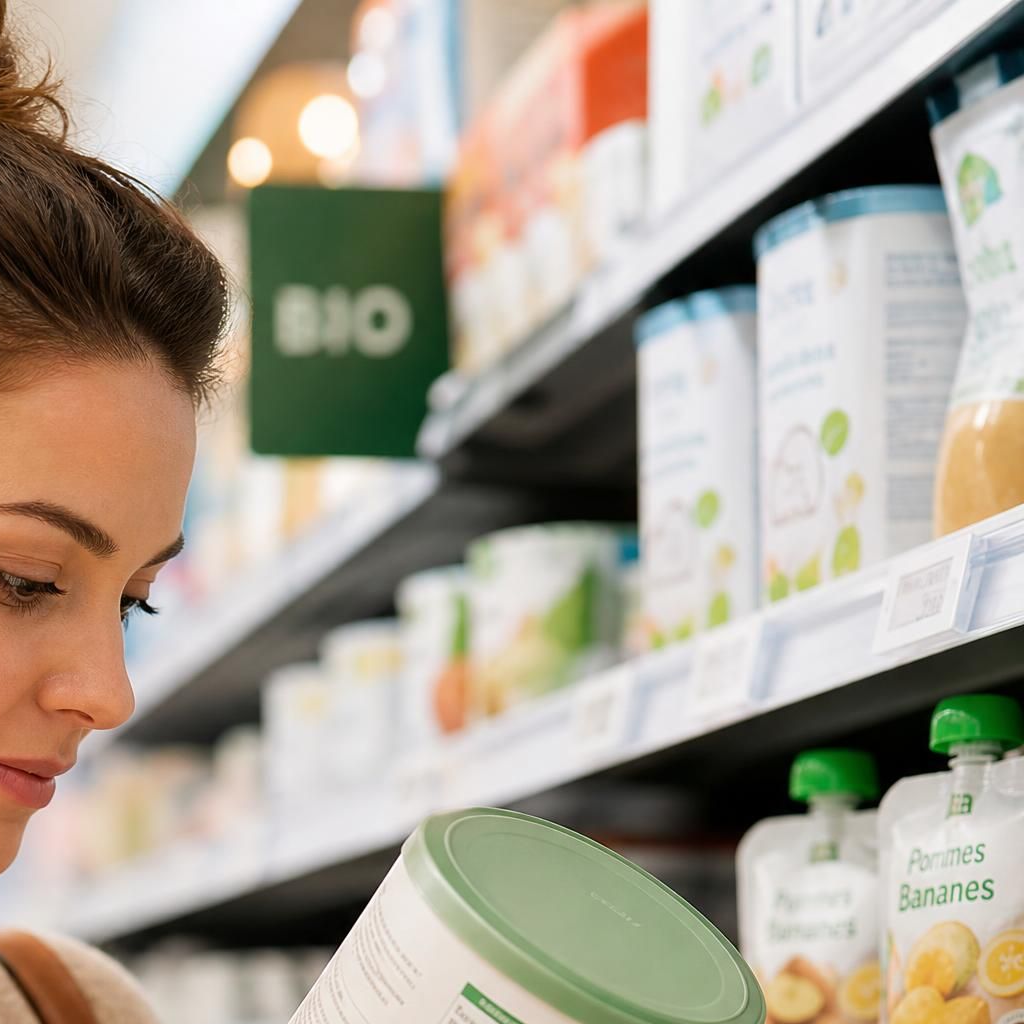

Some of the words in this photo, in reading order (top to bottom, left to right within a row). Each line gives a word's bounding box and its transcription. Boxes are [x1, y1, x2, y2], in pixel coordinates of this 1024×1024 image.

[275, 284, 412, 357] BIO
[907, 843, 986, 874] Pommes
[898, 878, 995, 912] Bananes
